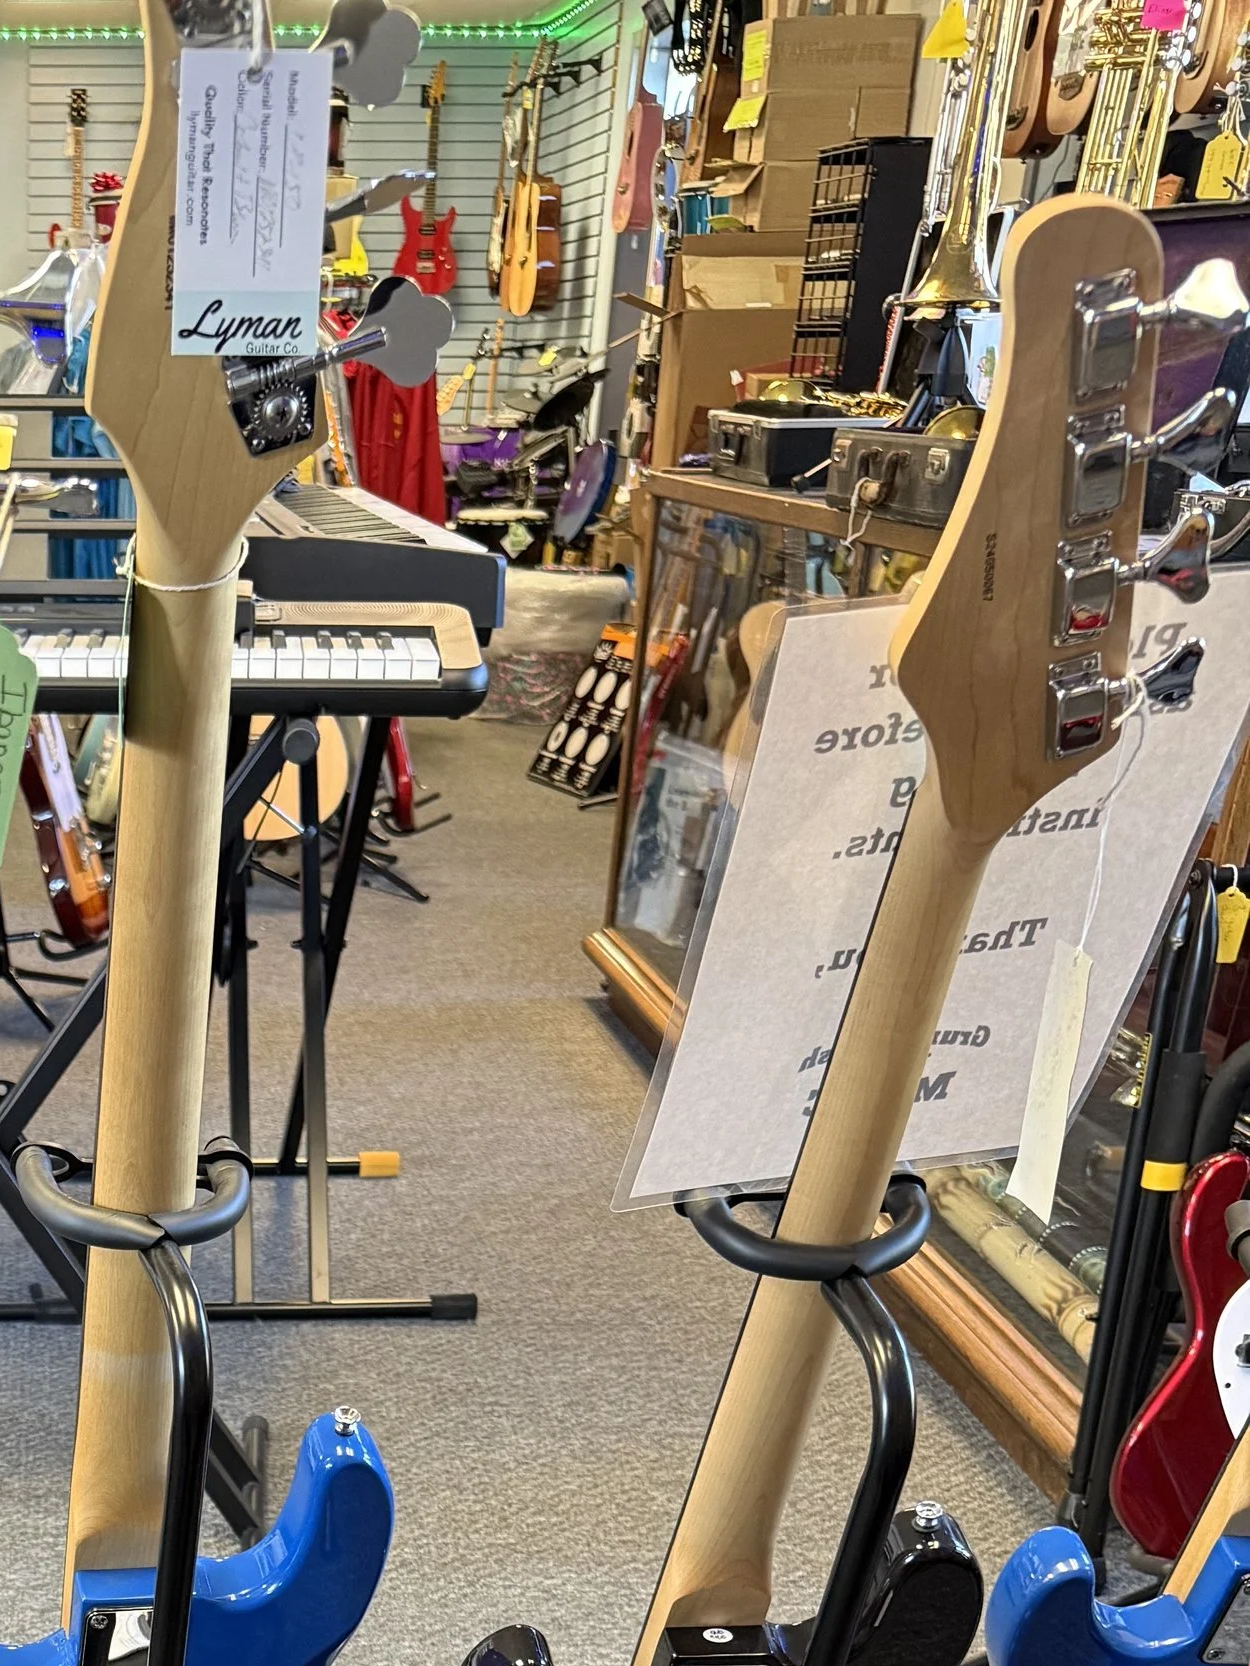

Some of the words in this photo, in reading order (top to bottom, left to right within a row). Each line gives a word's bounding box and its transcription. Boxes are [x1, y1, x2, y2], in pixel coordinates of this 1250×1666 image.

[200, 83, 218, 140] Quality
[260, 70, 273, 111] Serial
[184, 110, 200, 227] lymanguitar.com
[200, 142, 215, 173] That
[200, 176, 214, 246] Resonates
[178, 300, 303, 354] Lyman
[246, 342, 280, 354] Guitar
